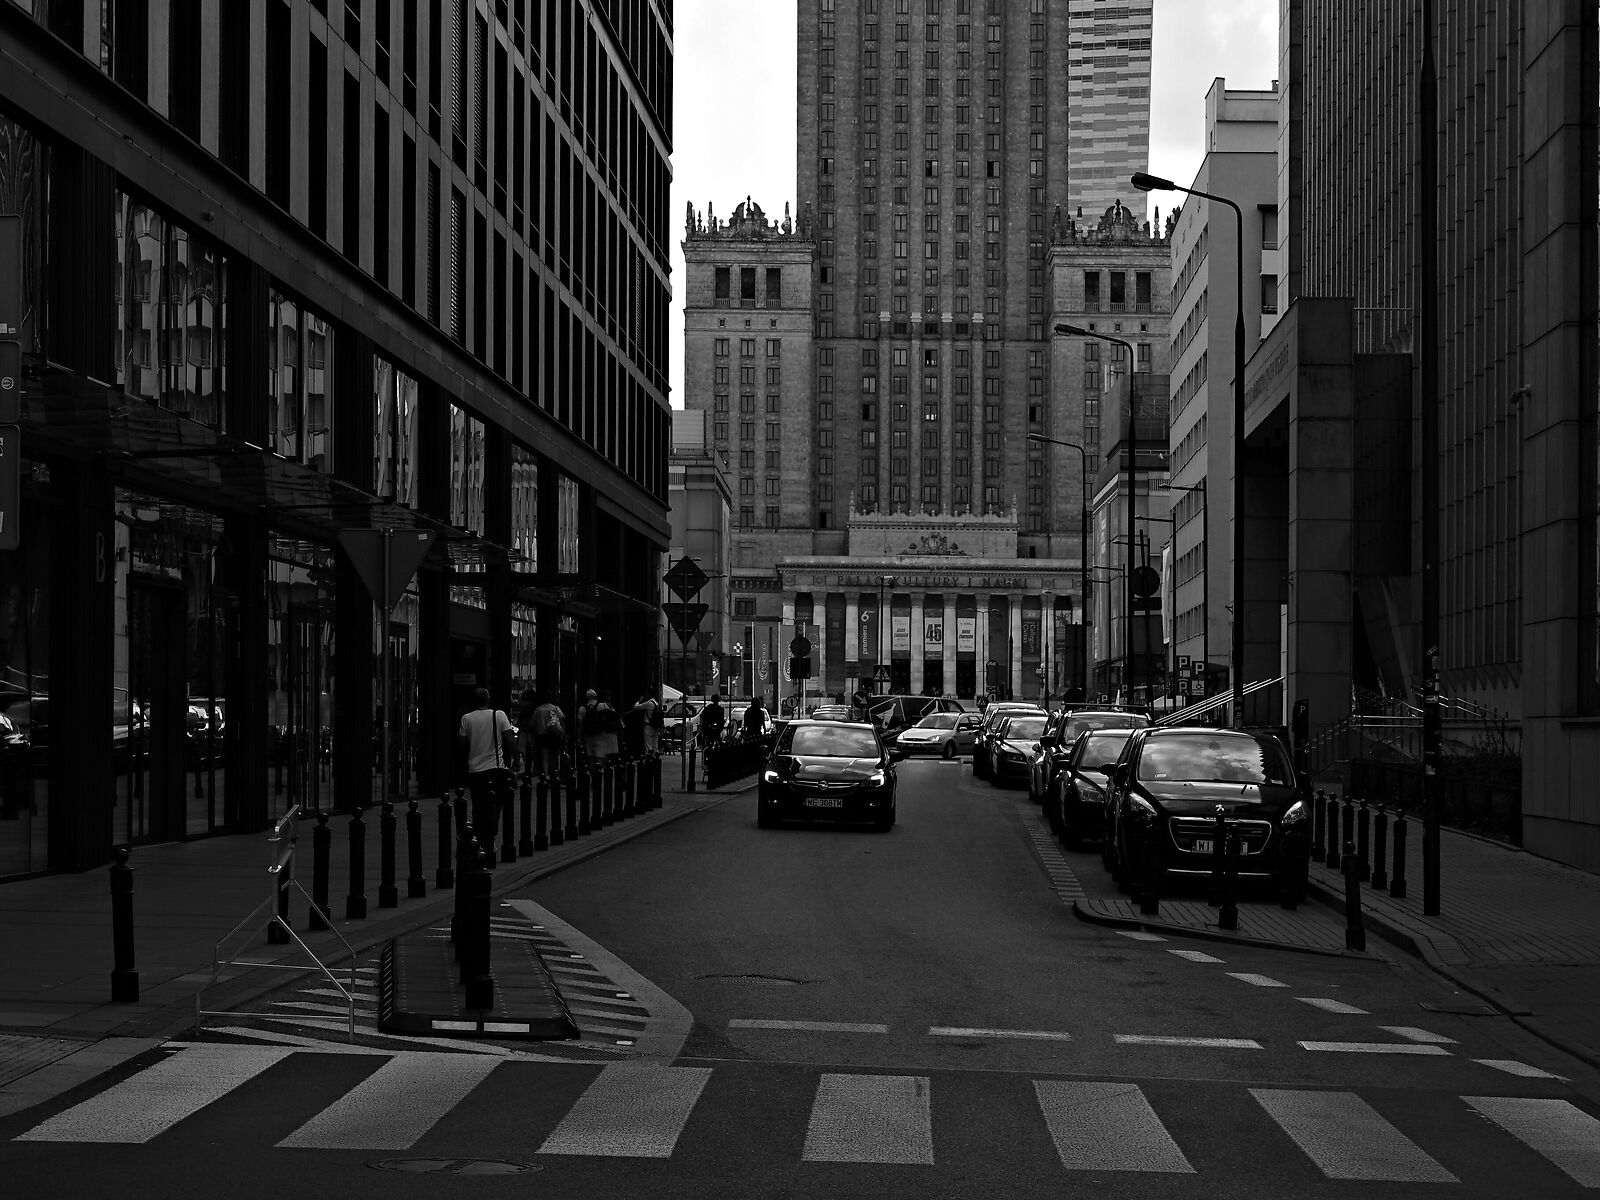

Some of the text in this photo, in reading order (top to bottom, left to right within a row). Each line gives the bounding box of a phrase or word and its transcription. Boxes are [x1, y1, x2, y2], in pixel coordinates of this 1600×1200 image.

[892, 576, 959, 587] KULTURY
[925, 623, 942, 642] 45
[1178, 656, 1188, 669] P
[1195, 662, 1205, 675] P
